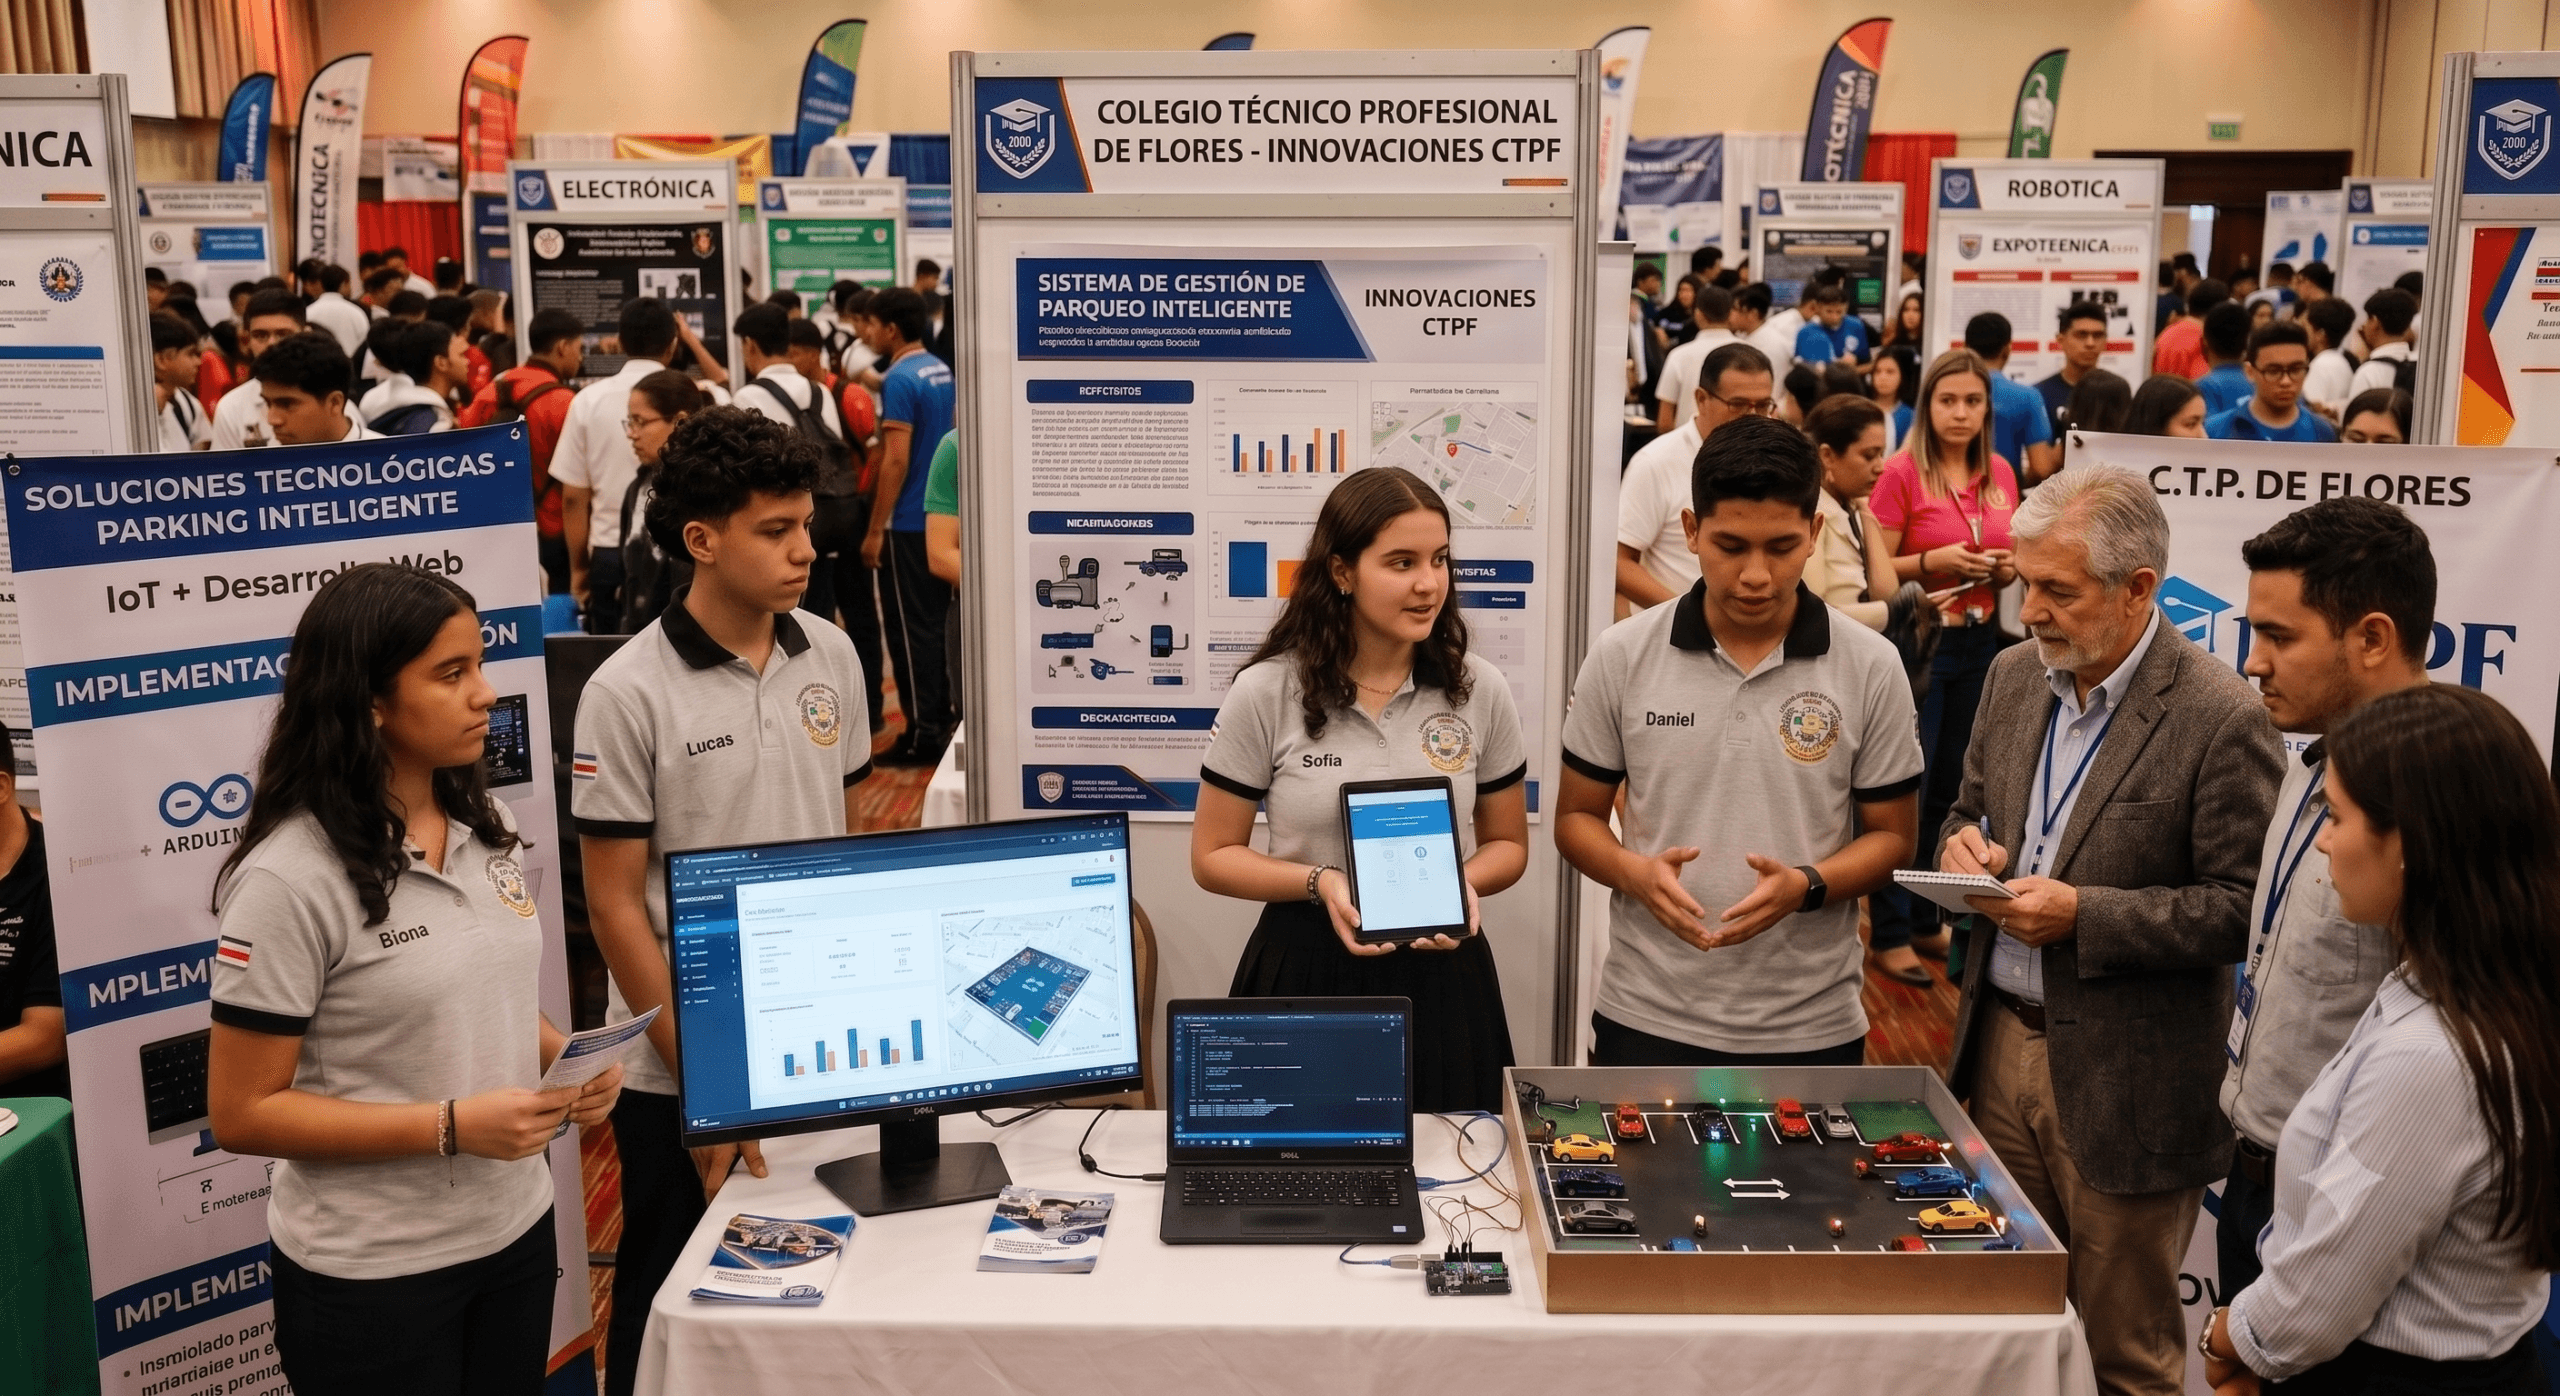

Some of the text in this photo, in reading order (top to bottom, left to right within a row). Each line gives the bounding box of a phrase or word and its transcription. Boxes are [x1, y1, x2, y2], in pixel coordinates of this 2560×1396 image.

[1097, 94, 1558, 125] COLEGIO TÉCNICO PROFESIONAL
[1008, 134, 1032, 148] 2000
[1094, 138, 1131, 163] DE
[1139, 137, 1243, 163] FLORES
[1268, 137, 1484, 163] INNOVACIONES
[1491, 137, 1562, 163] CTPF
[2502, 136, 2526, 150] 2000
[563, 177, 714, 198] ELECTRÓNICA
[2008, 180, 2119, 198] ROBOTICA
[1038, 269, 1305, 293] SISTEMA DE GESTIÓN DE
[1364, 289, 1536, 308] INNOVACIONES
[1038, 299, 1292, 322] PARQUEO INTELIGENTE
[1422, 318, 1478, 336] CTPF
[25, 472, 246, 511] SOLUCIONES
[254, 454, 496, 494] TECNOLÓGICAS
[2149, 465, 2245, 498] C.T.P.
[2256, 470, 2307, 501] DE
[97, 491, 458, 545] PARKING INTELIGENTE
[106, 581, 160, 613] IoT
[173, 583, 190, 601] +
[1645, 711, 1695, 727] Daniel
[686, 735, 734, 756] Lucas
[1302, 754, 1342, 768] Sofia
[379, 925, 429, 949] Biona
[239, 1348, 260, 1365] un
